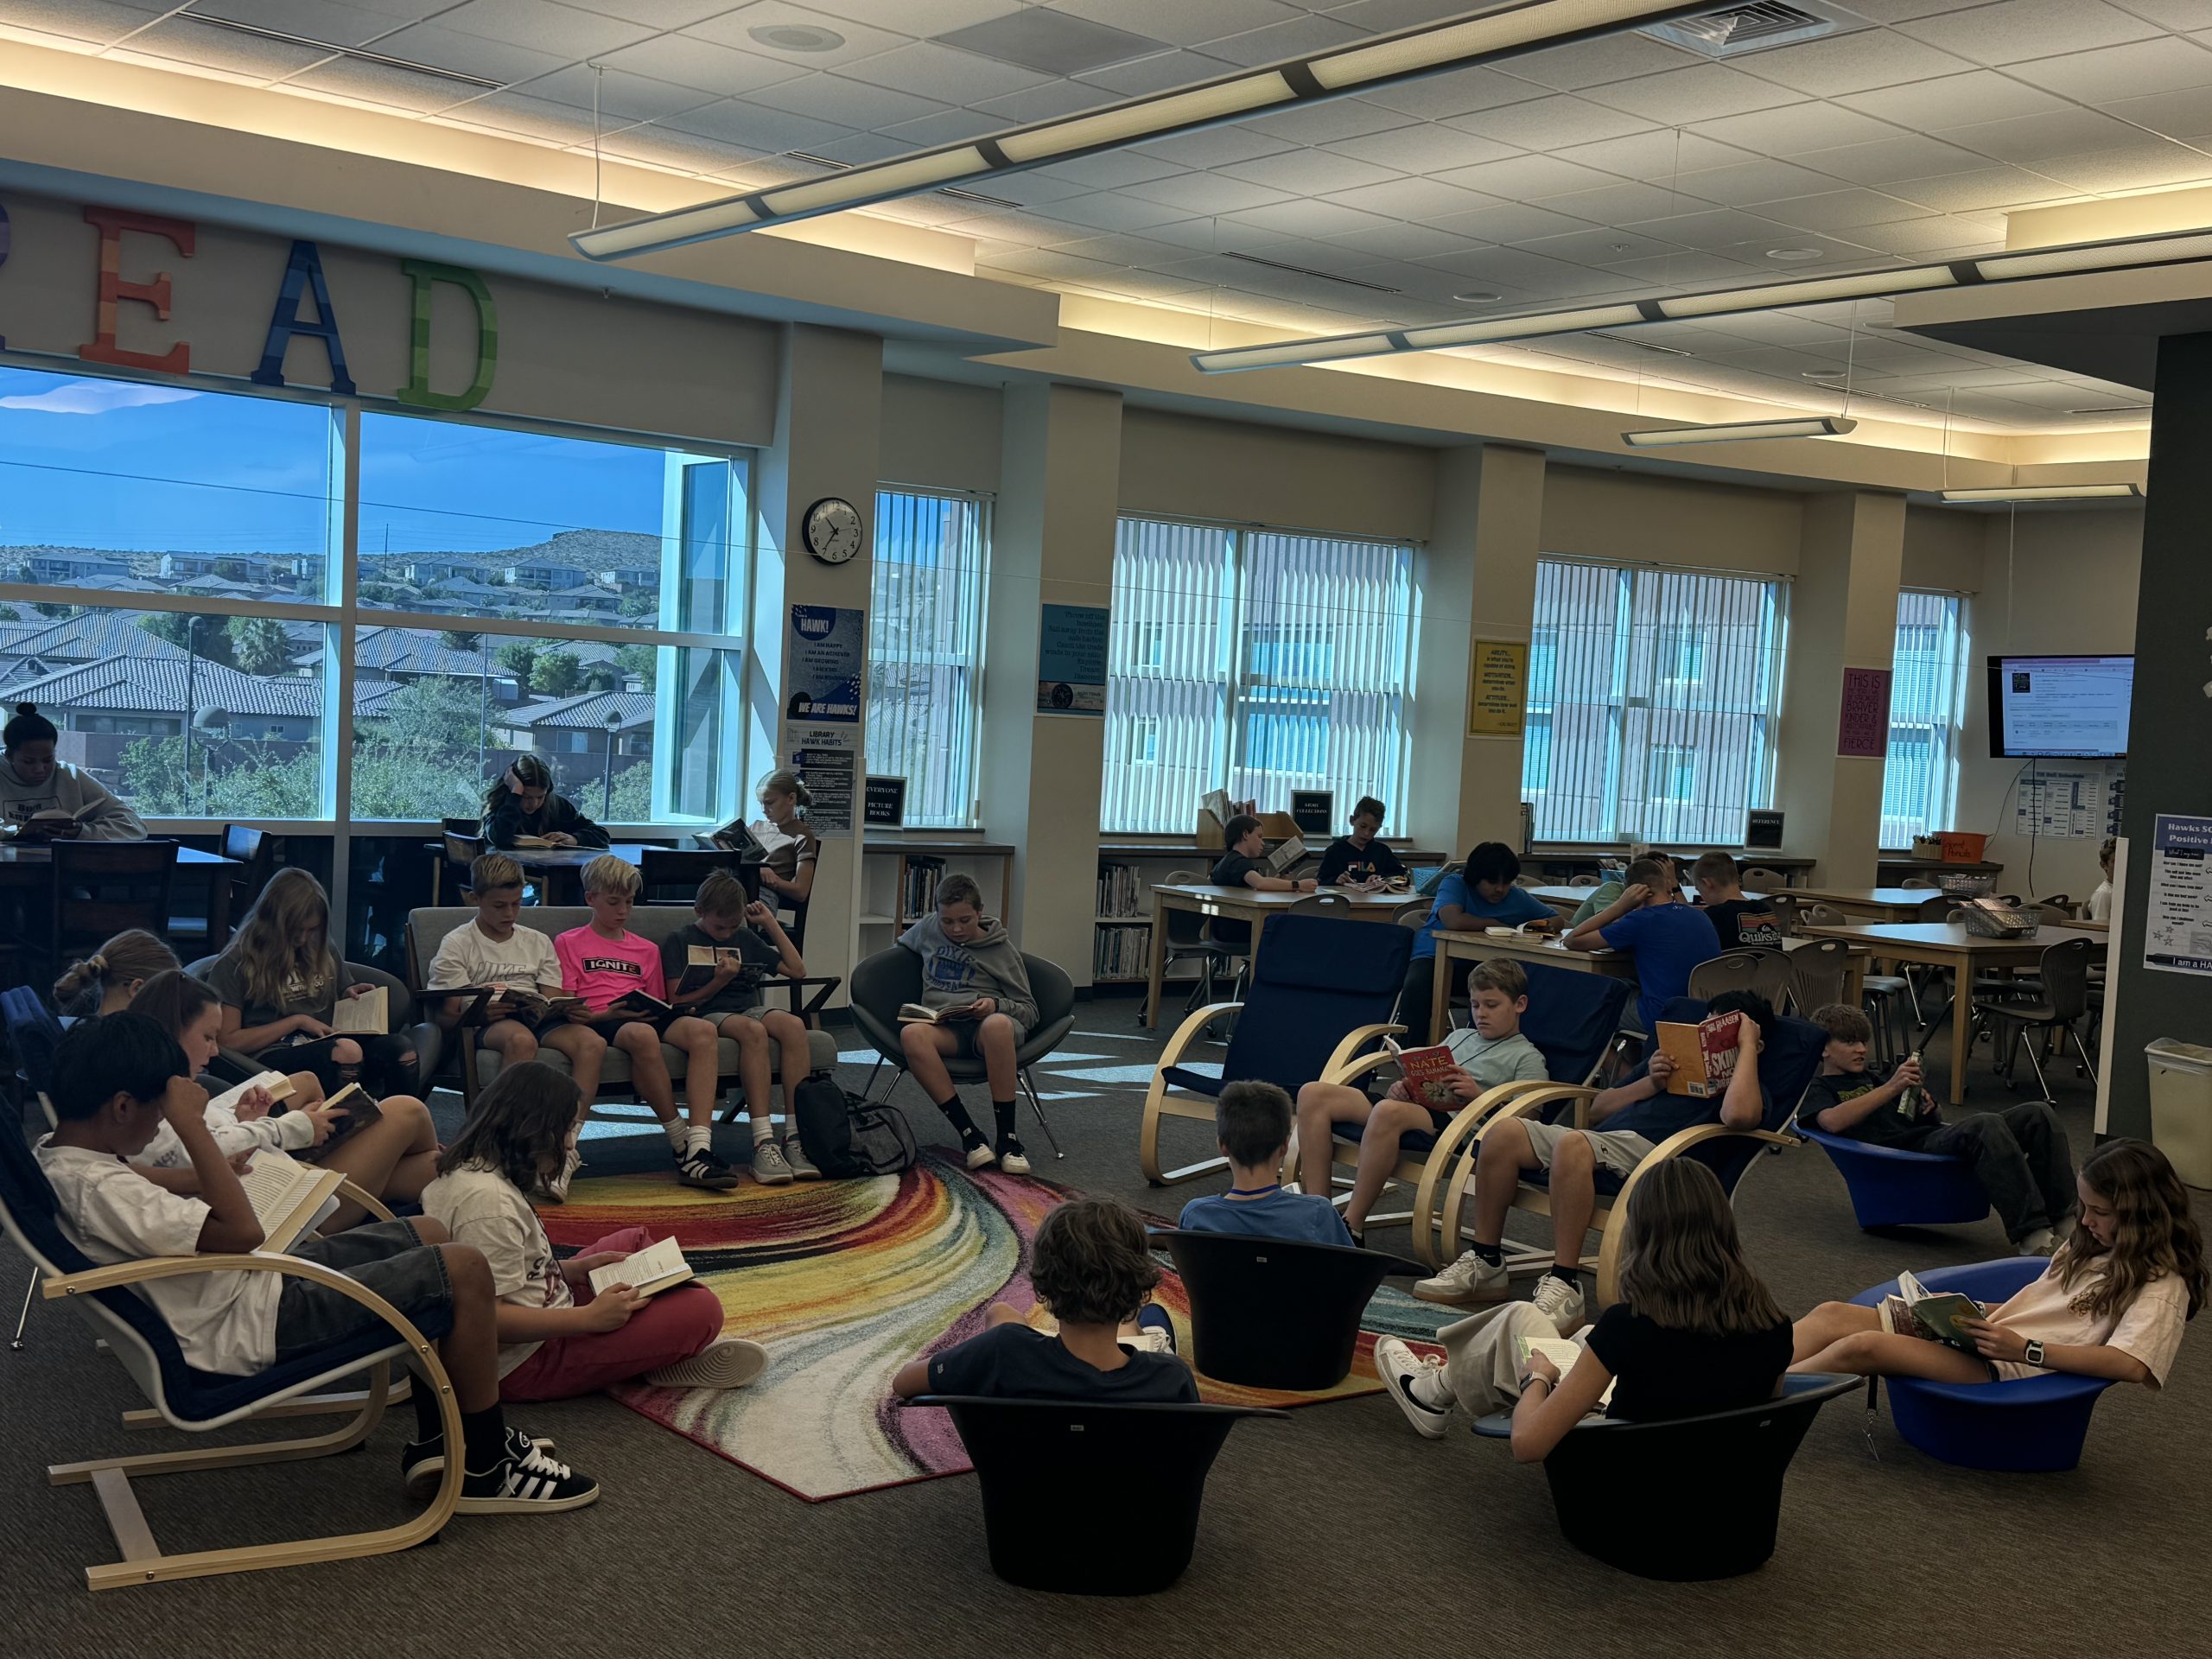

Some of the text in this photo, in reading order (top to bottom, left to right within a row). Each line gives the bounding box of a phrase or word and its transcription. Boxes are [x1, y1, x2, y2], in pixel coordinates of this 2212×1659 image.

[0, 204, 498, 413] EAD
[832, 501, 840, 511] 12
[850, 516, 855, 525] 2
[854, 529, 859, 537] 3
[814, 537, 819, 546] 8
[850, 541, 855, 550] 4
[822, 547, 827, 556] 7
[831, 551, 837, 560] 6
[842, 549, 848, 557] 5
[800, 618, 830, 633] HAWK!
[1848, 673, 1881, 690] THIS IS
[798, 702, 857, 716] WE ARE HAWKS!
[1844, 737, 1876, 750] FIERCE
[2168, 823, 2200, 832] Hawks
[2169, 834, 2209, 844] Positive
[1348, 861, 1376, 873] FILA
[937, 945, 975, 966] DIXIE
[2172, 957, 2176, 965] I
[590, 959, 638, 974] IGNITE
[471, 961, 526, 986] NIKE
[1409, 1056, 1449, 1071] NATE
